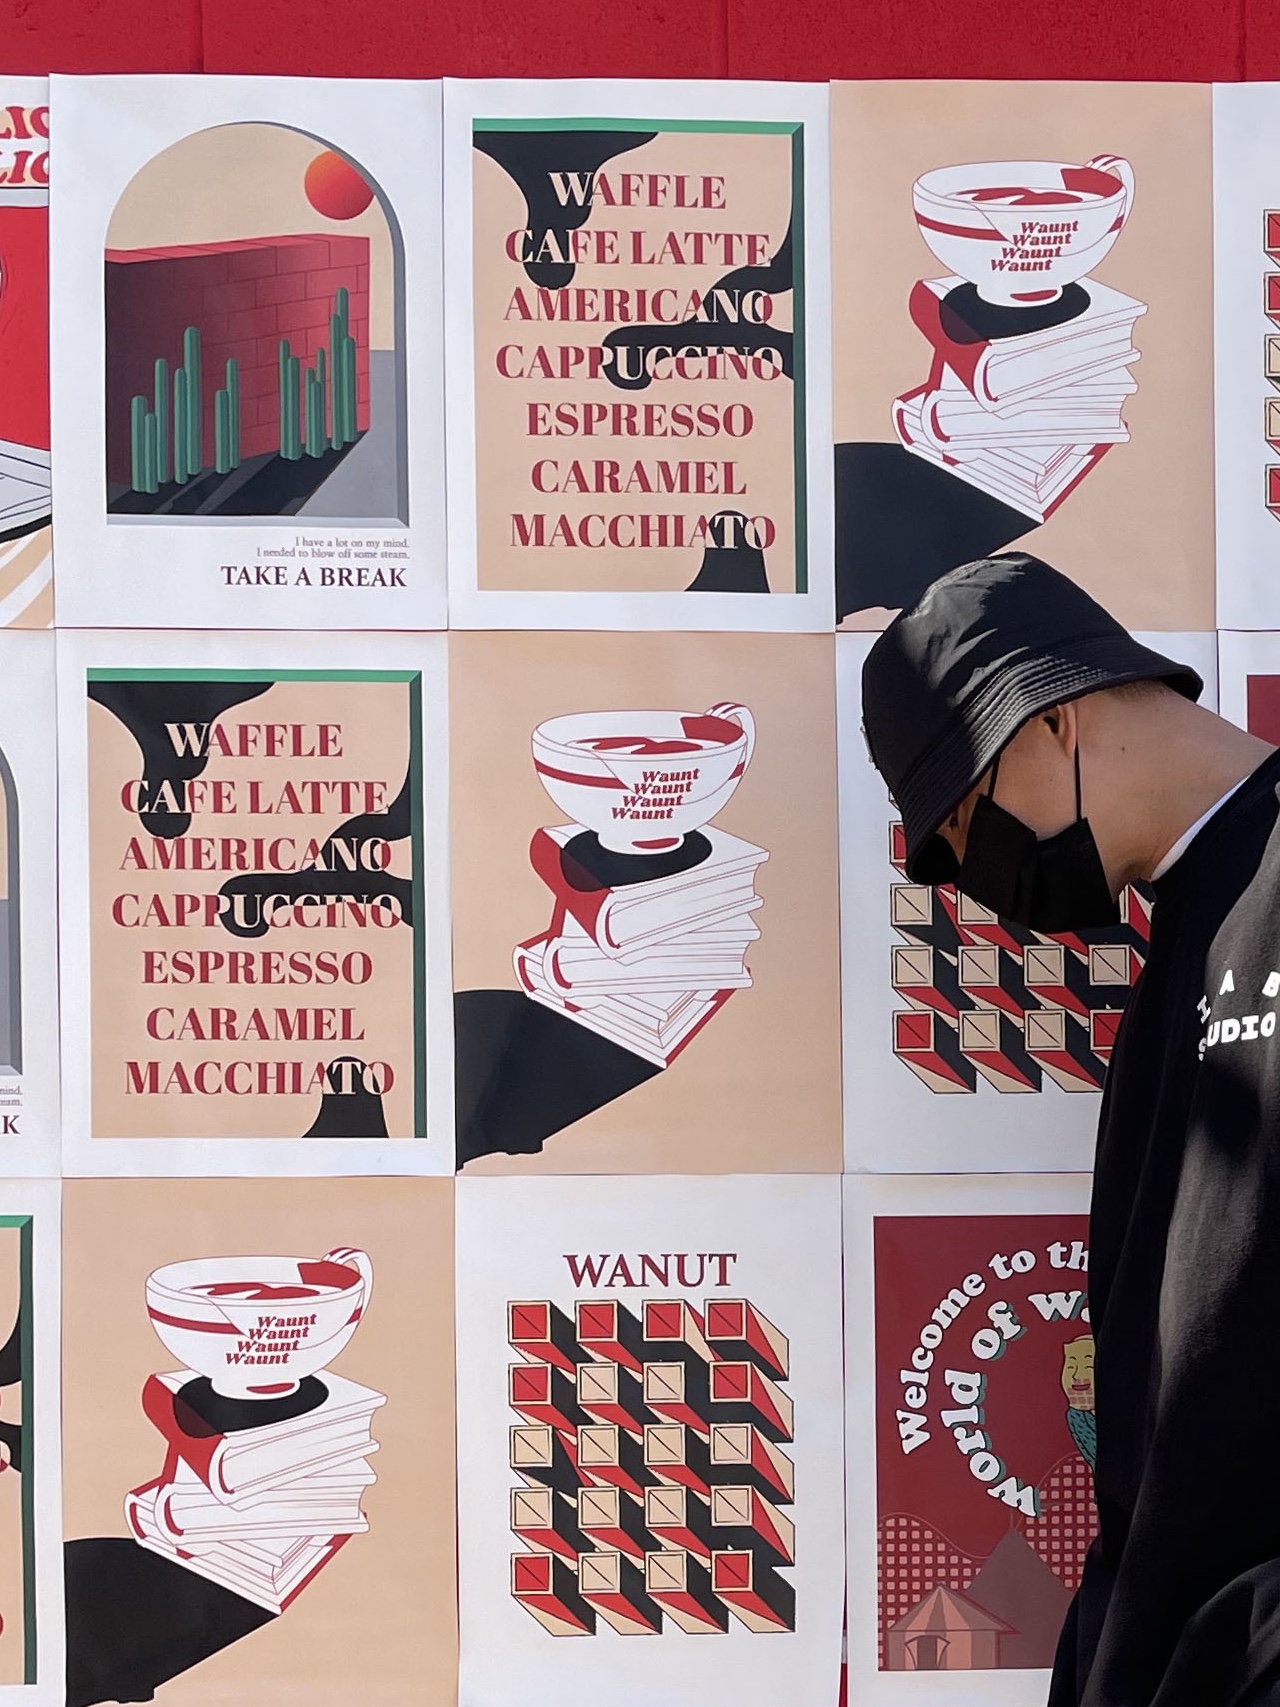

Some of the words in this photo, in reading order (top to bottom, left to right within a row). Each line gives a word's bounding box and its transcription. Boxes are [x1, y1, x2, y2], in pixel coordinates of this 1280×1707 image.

[547, 172, 726, 209] WAFFLE
[1012, 233, 1072, 246] Waunt
[1021, 220, 1079, 234] Waunt
[505, 228, 620, 264] CAFE
[630, 231, 772, 267] LATTE
[1002, 246, 1062, 259] Waunt
[990, 259, 1052, 272] Waunt
[503, 286, 773, 324] AMERICANO
[496, 344, 783, 381] CAPPUCCINO
[526, 402, 754, 437] ESPRESSO
[531, 459, 747, 494] CARAMEL
[302, 536, 325, 547] have
[336, 537, 348, 547] lot
[351, 540, 363, 548] on
[366, 540, 380, 550] my
[383, 538, 410, 548] mind.
[510, 514, 776, 550] MACCHIATO
[264, 548, 295, 558] needed
[298, 549, 308, 558] to
[312, 548, 334, 558] blow
[338, 548, 351, 558] off
[380, 550, 410, 559] steam.
[221, 566, 288, 586] TAKE
[294, 567, 312, 586] A
[320, 567, 407, 587] BREAK
[164, 722, 344, 758] WAFFLE
[634, 781, 693, 794] Waunt
[642, 768, 700, 782] Waunt
[120, 778, 237, 814] CAFE
[247, 780, 389, 815] LATTE
[623, 794, 684, 808] Waunt
[612, 808, 674, 820] Waunt
[120, 836, 392, 872] AMERICANO
[112, 894, 403, 929] CAPPUCCINO
[142, 950, 373, 984] ESPRESSO
[146, 1006, 365, 1042] CARAMEL
[124, 1060, 395, 1096] MACCHIATO
[562, 1253, 738, 1288] WANUT
[249, 1326, 310, 1340] Waunt
[258, 1314, 318, 1328] Waunt
[226, 1352, 290, 1365] Waunt
[238, 1340, 300, 1352] Waunt
[896, 1273, 986, 1454] Welcome
[988, 1250, 1036, 1280] to
[1046, 1240, 1088, 1272] th
